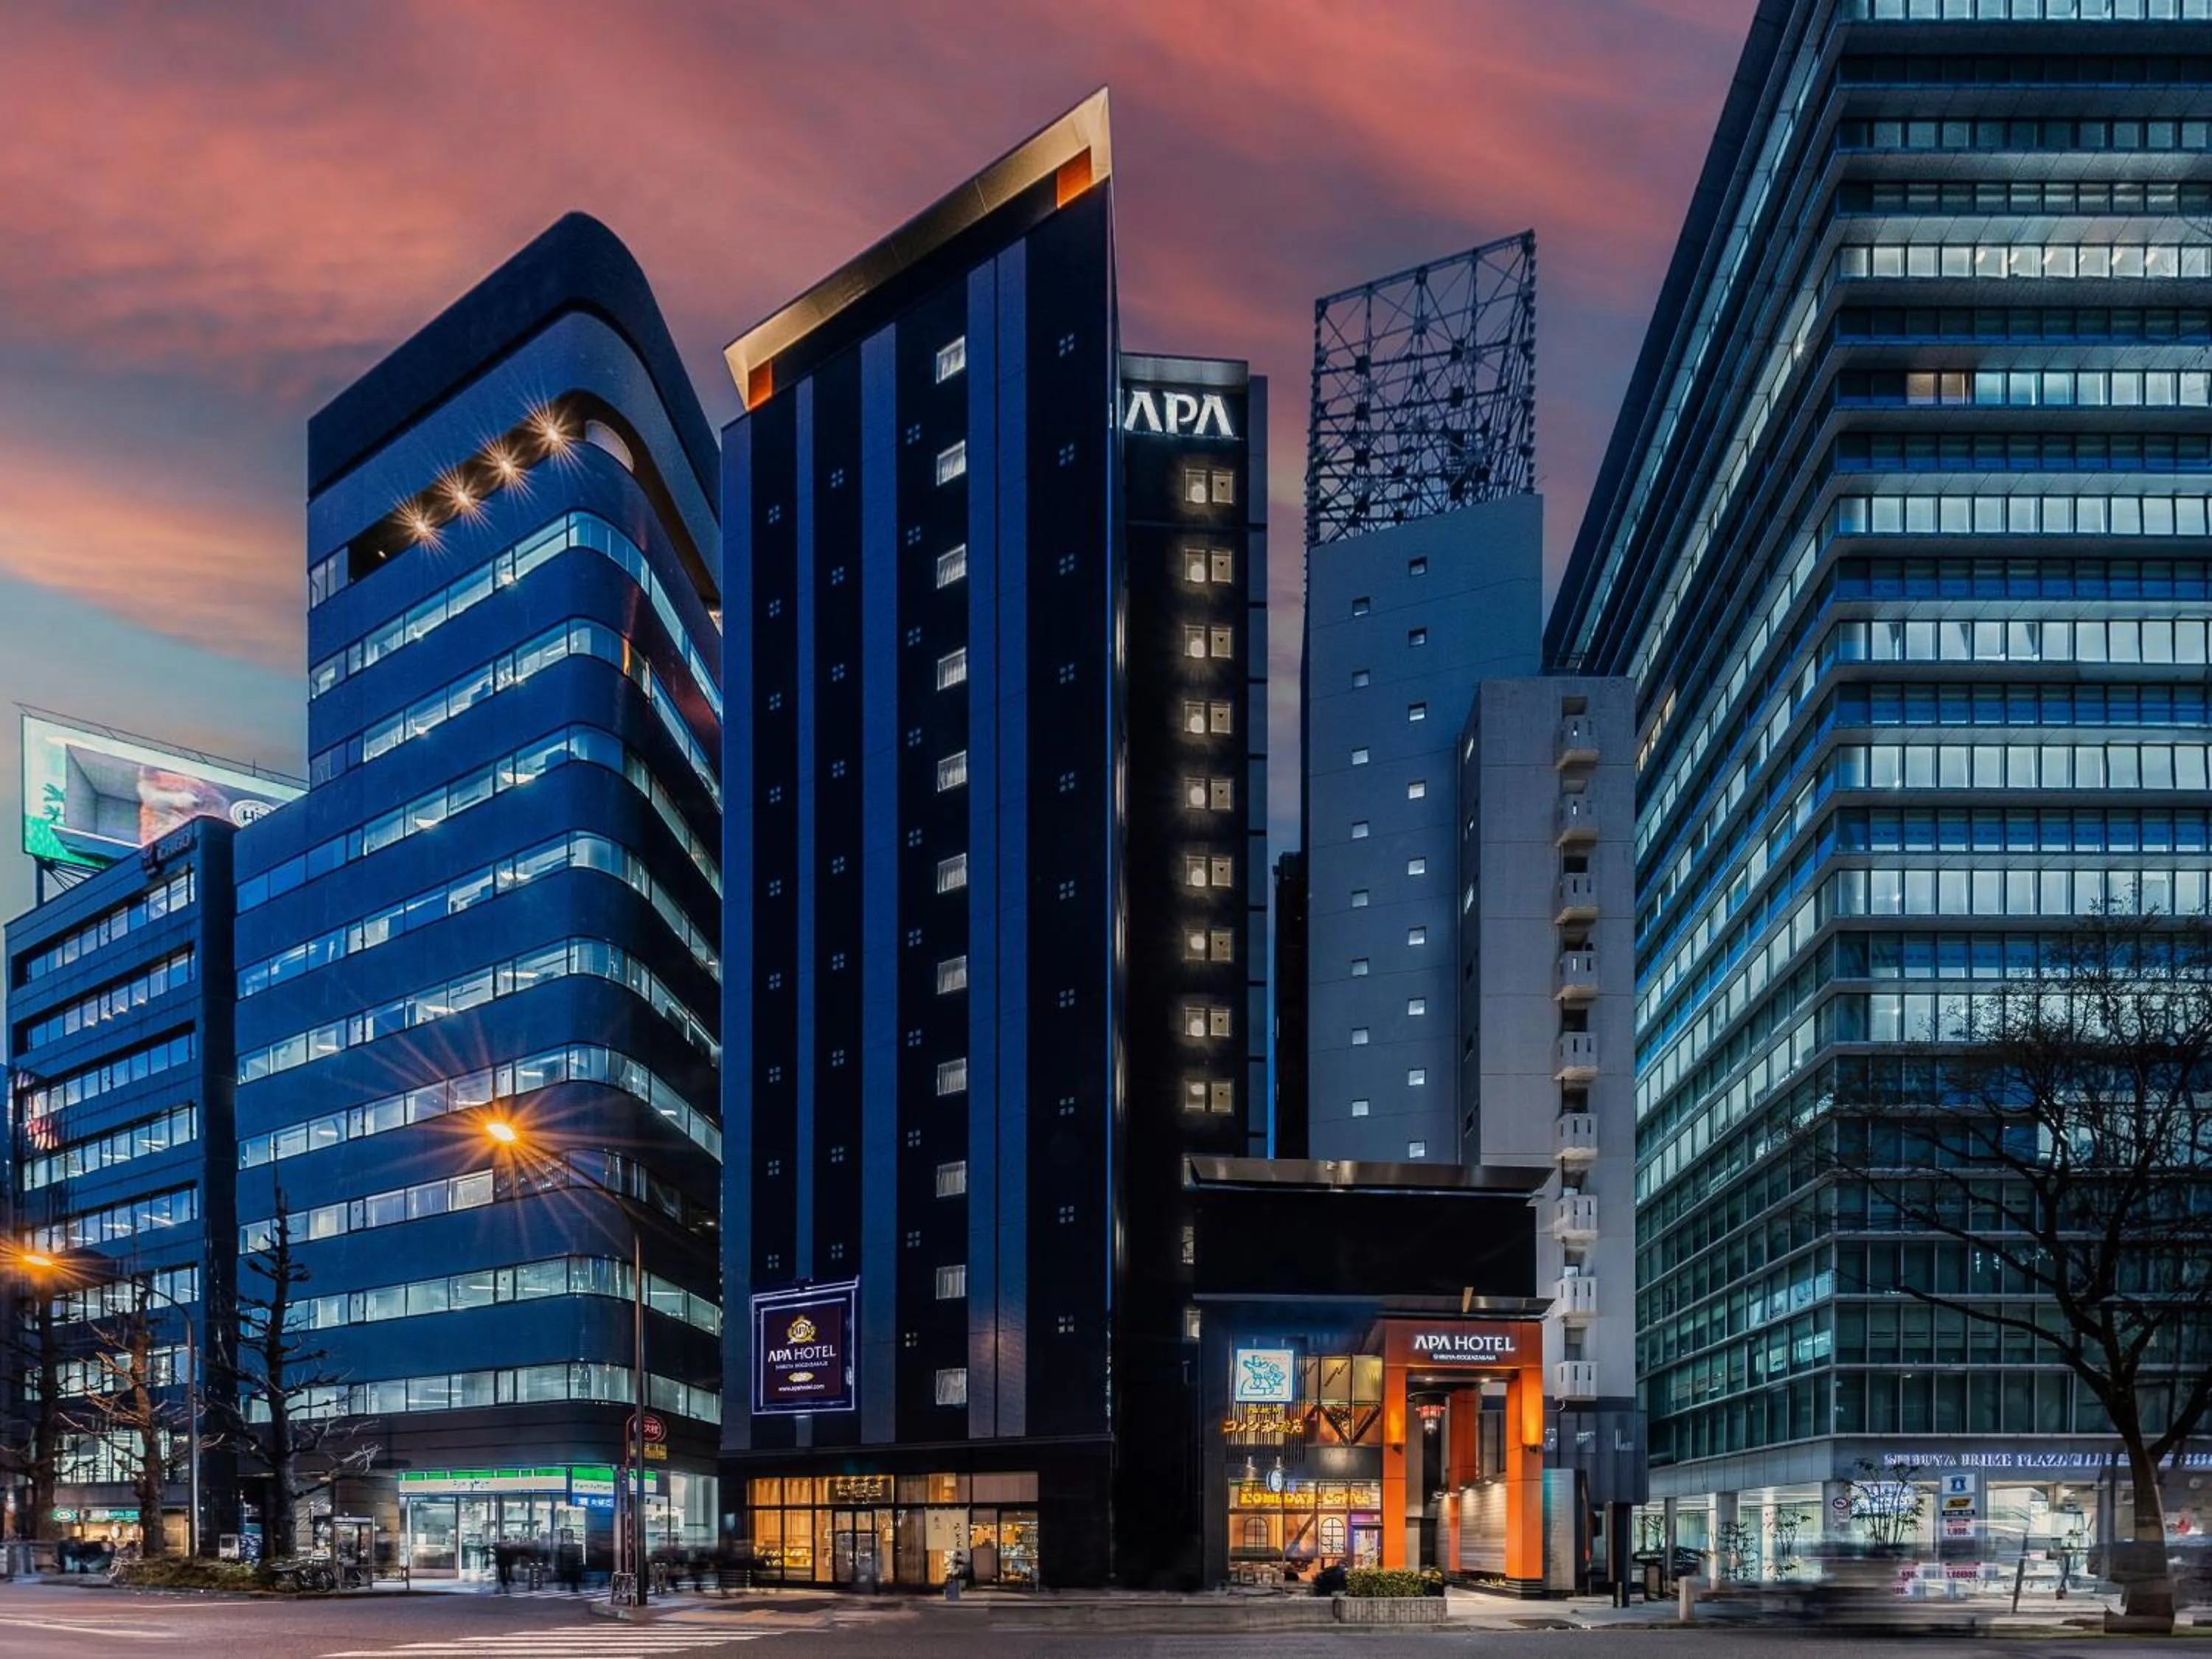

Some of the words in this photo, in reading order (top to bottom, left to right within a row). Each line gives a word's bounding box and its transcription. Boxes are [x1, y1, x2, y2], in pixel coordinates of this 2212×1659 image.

[1124, 390, 1234, 437] APA
[1414, 1335, 1451, 1351] APA
[1455, 1335, 1515, 1352] HOTEL
[768, 1349, 793, 1363] APA
[794, 1344, 837, 1360] HOTEL
